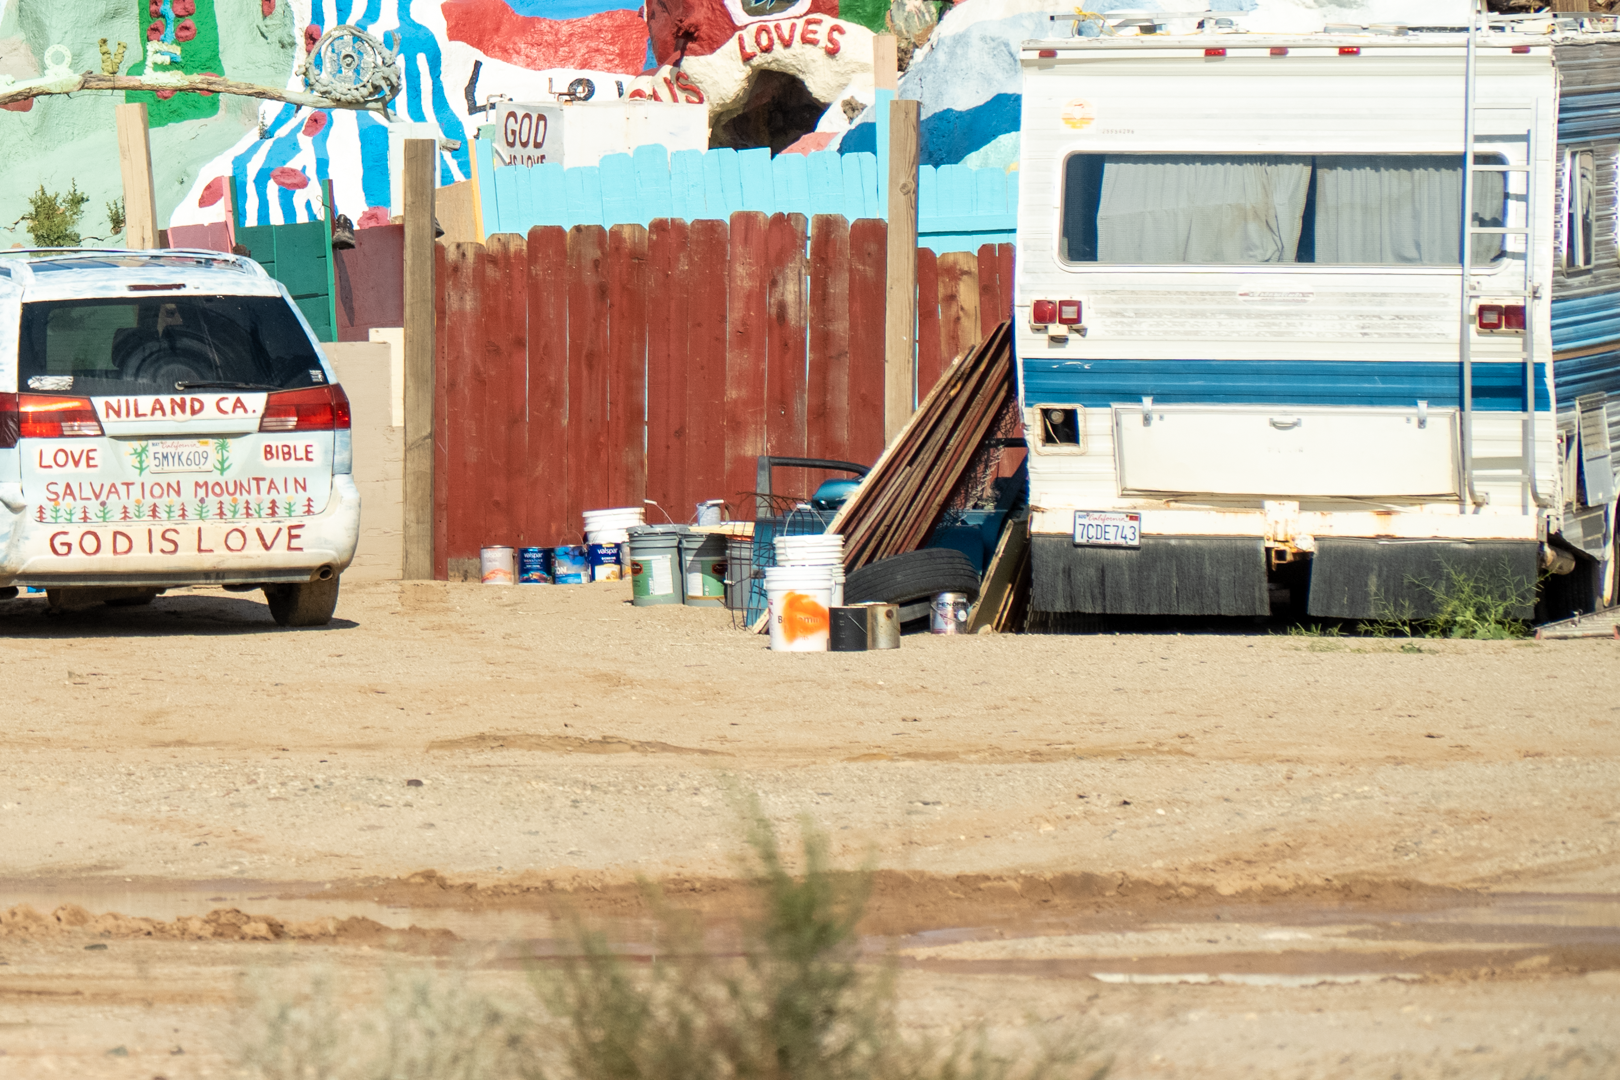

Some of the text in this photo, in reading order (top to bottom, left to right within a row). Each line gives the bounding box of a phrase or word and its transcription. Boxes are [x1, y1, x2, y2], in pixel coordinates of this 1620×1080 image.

[738, 18, 846, 62] LOVES
[504, 111, 547, 149] GOD
[104, 396, 256, 418] NILAND CA.
[39, 449, 99, 469] LOVE
[153, 450, 209, 467] 5MYK609
[263, 444, 314, 462] BIBLE
[46, 477, 307, 501] SALVATION MOUNTAIN
[49, 524, 305, 556] GOD IS LOVE
[1079, 523, 1136, 541] 7CDE743
